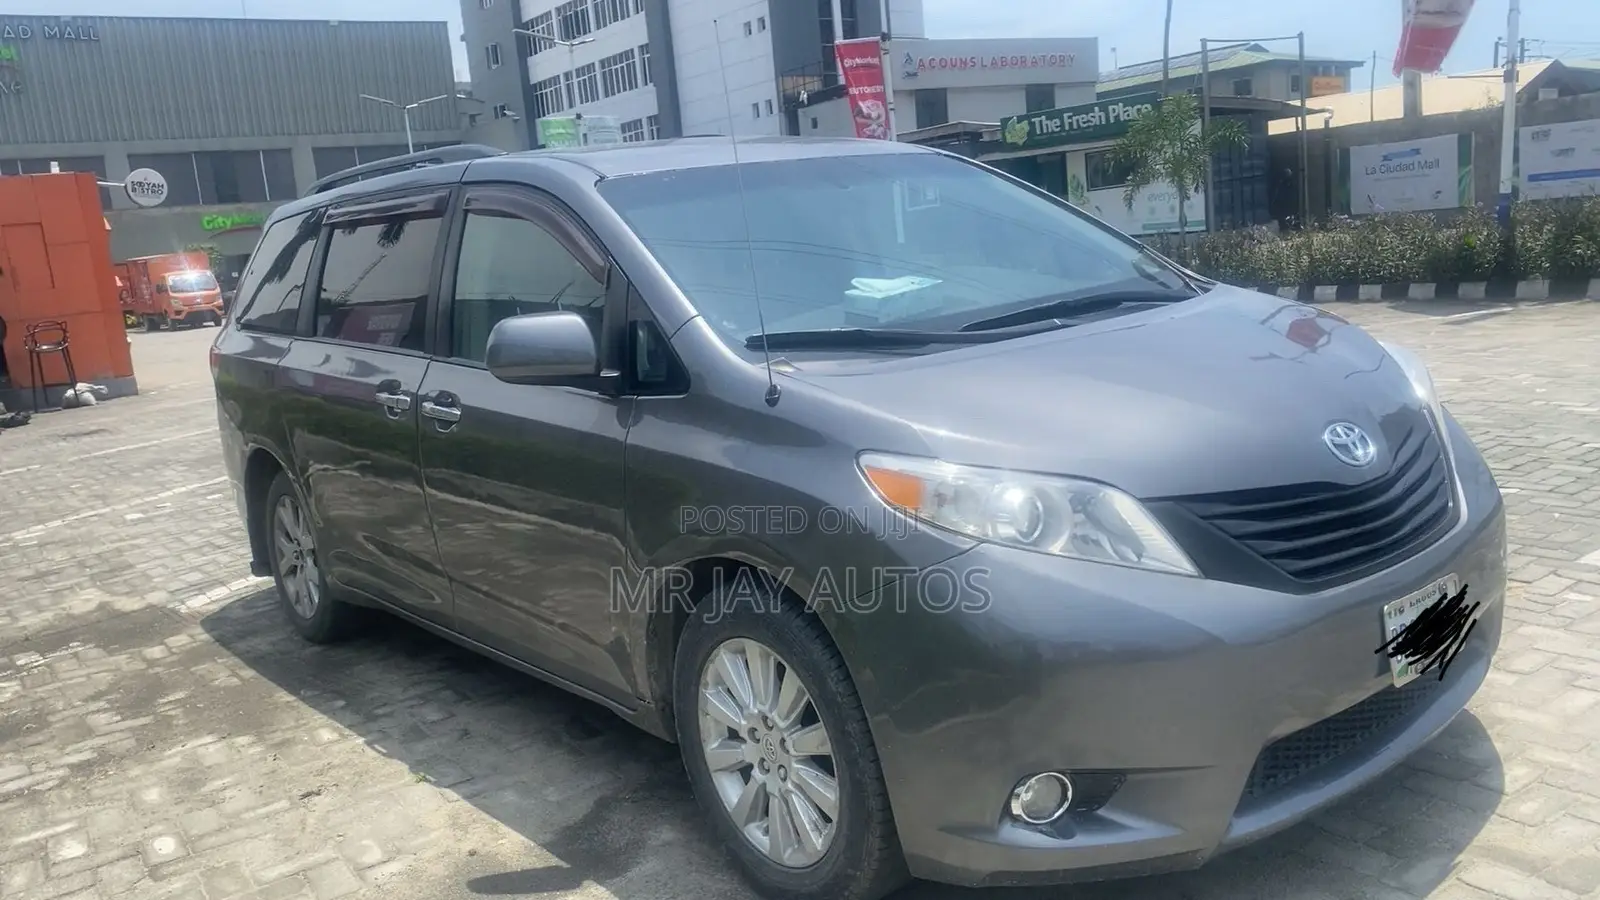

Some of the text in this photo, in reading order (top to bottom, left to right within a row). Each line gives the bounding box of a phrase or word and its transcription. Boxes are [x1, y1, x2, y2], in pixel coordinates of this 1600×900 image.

[4, 25, 100, 40] AD MALL
[912, 54, 1077, 71] ACOUNS LABORATORY
[1032, 115, 1062, 135] The
[1063, 106, 1107, 130] Fresh
[1365, 157, 1440, 176] La Ciudad Mall
